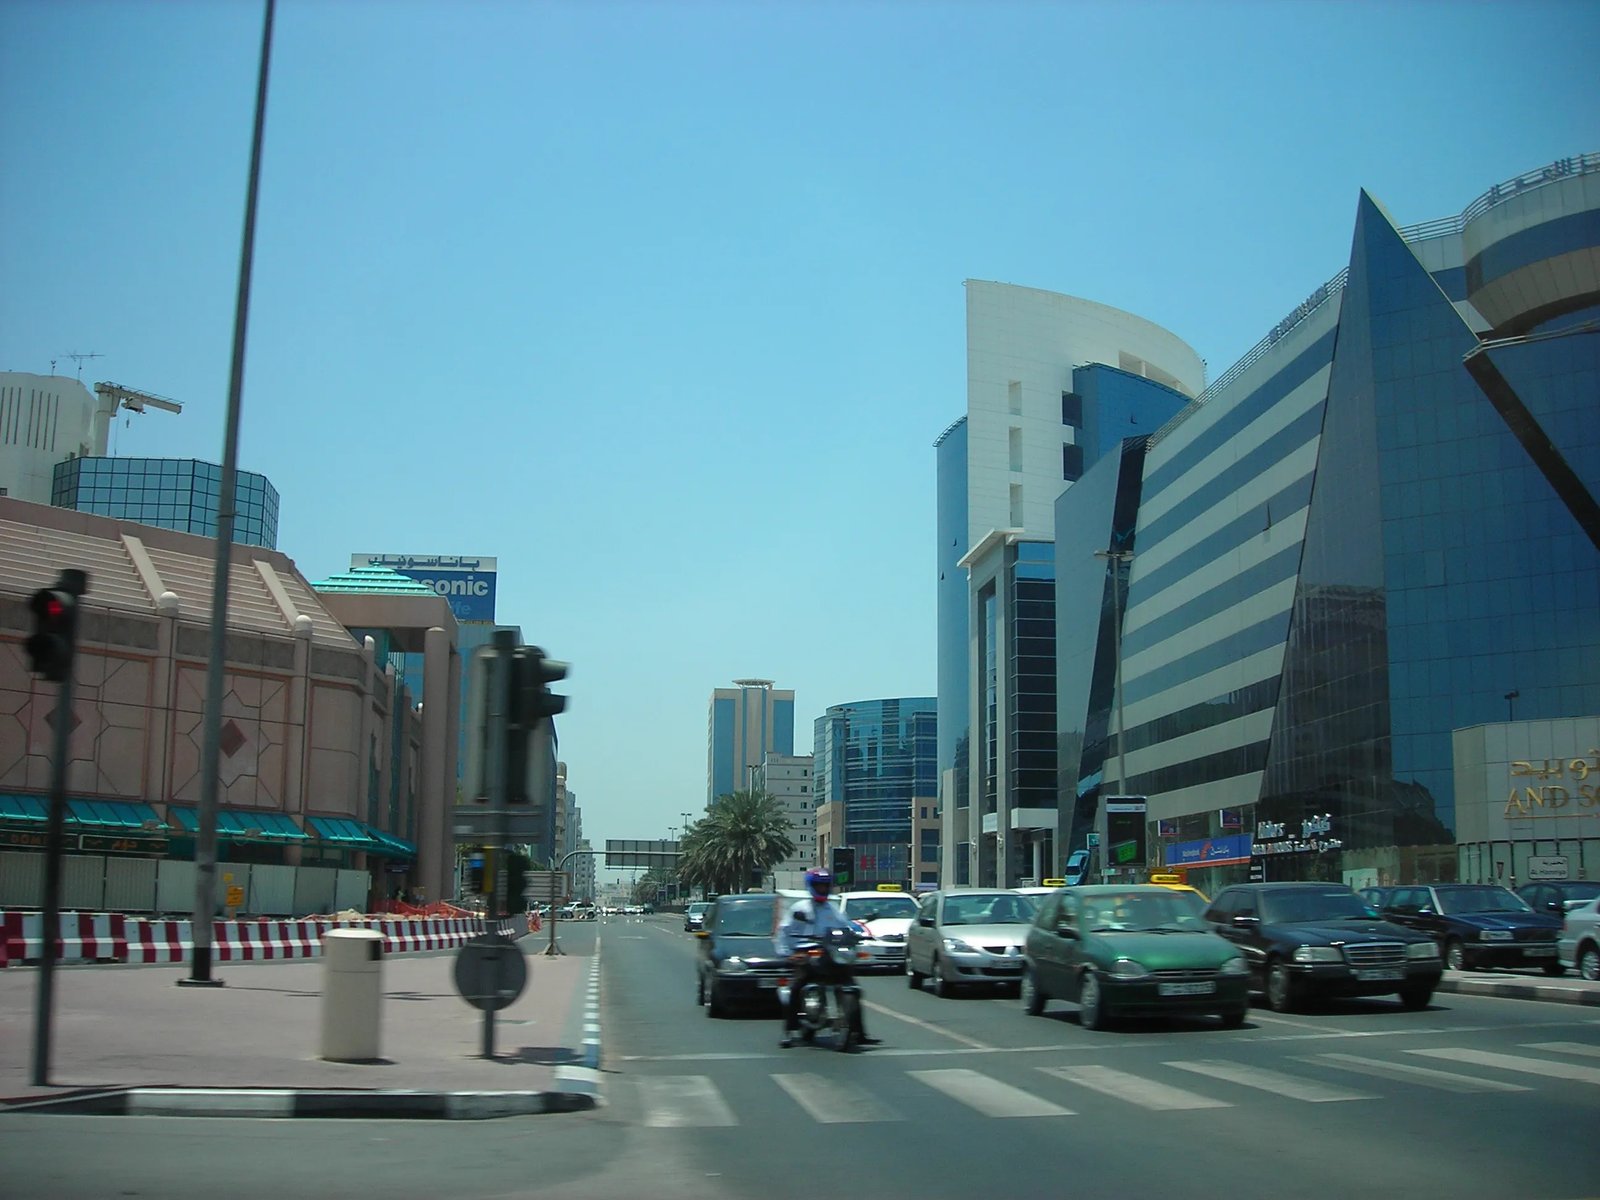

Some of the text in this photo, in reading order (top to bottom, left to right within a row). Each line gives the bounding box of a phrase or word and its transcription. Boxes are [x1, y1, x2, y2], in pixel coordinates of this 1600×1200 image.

[414, 575, 489, 597] sonic
[1504, 784, 1600, 815] AND S
